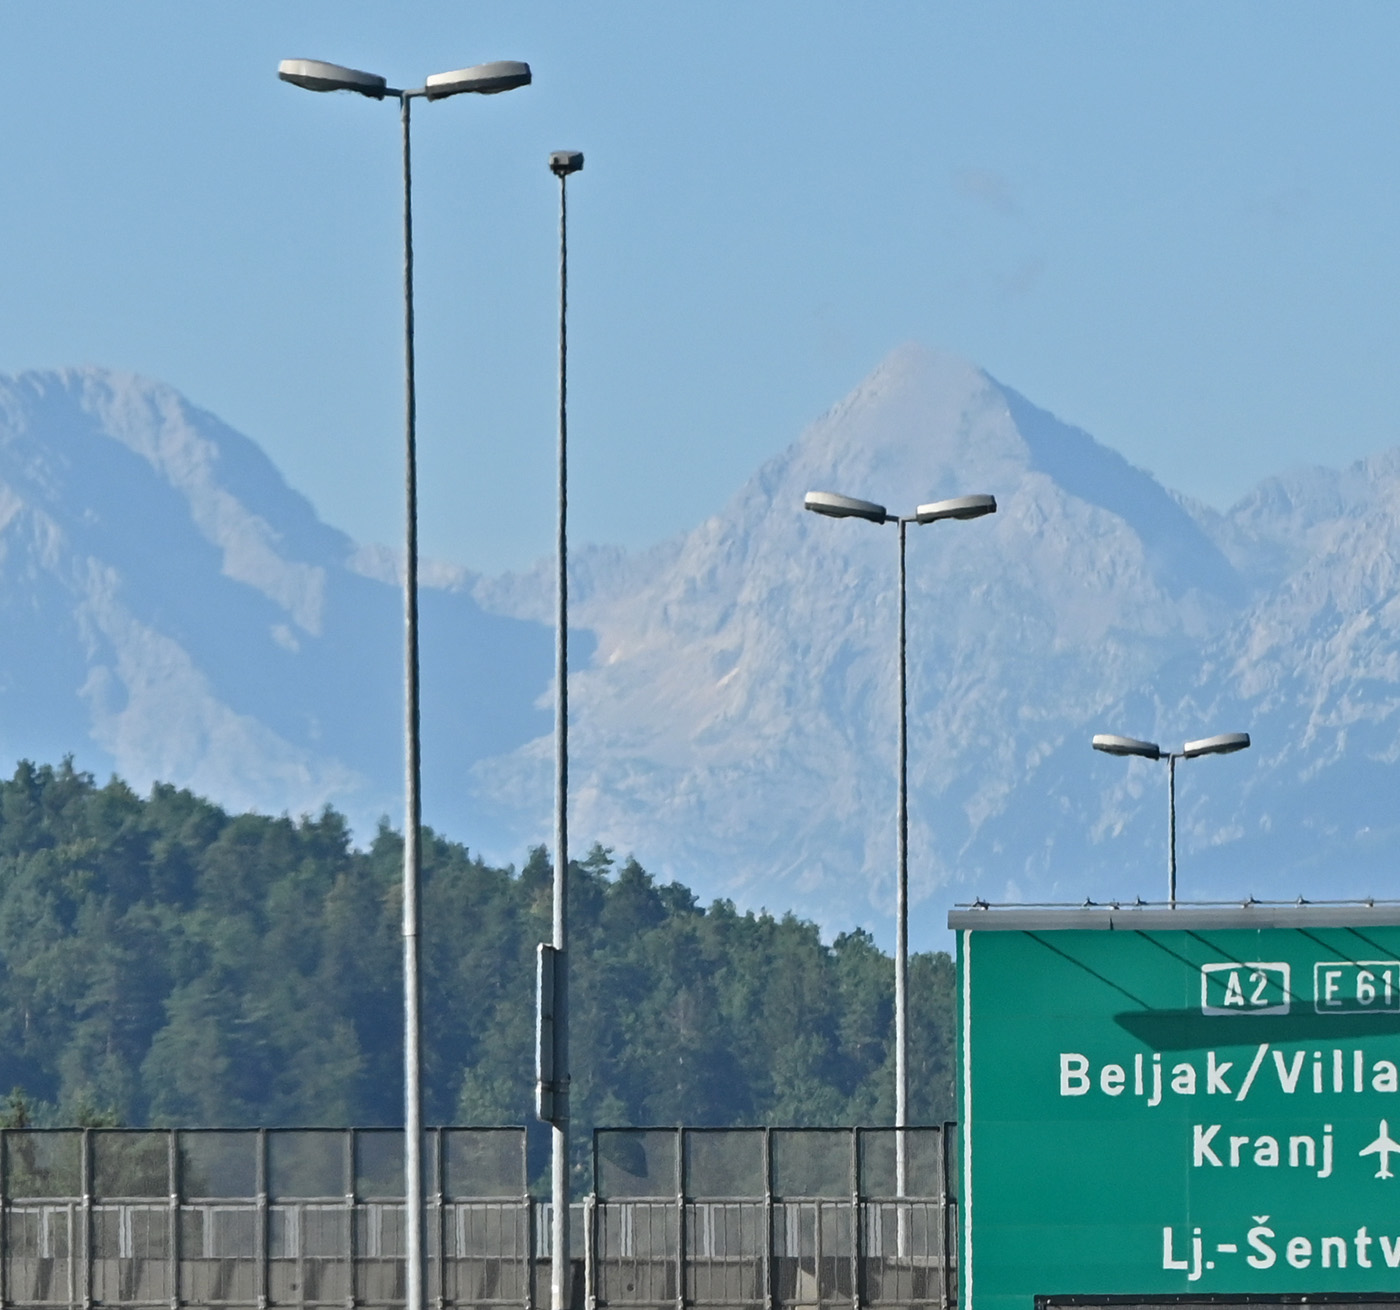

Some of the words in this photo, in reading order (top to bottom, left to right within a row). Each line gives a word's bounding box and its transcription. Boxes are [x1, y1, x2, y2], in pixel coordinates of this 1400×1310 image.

[1222, 970, 1271, 1006] A2
[1323, 970, 1343, 1005] E
[1355, 970, 1393, 1005] 61
[1192, 1123, 1334, 1178] Kranj
